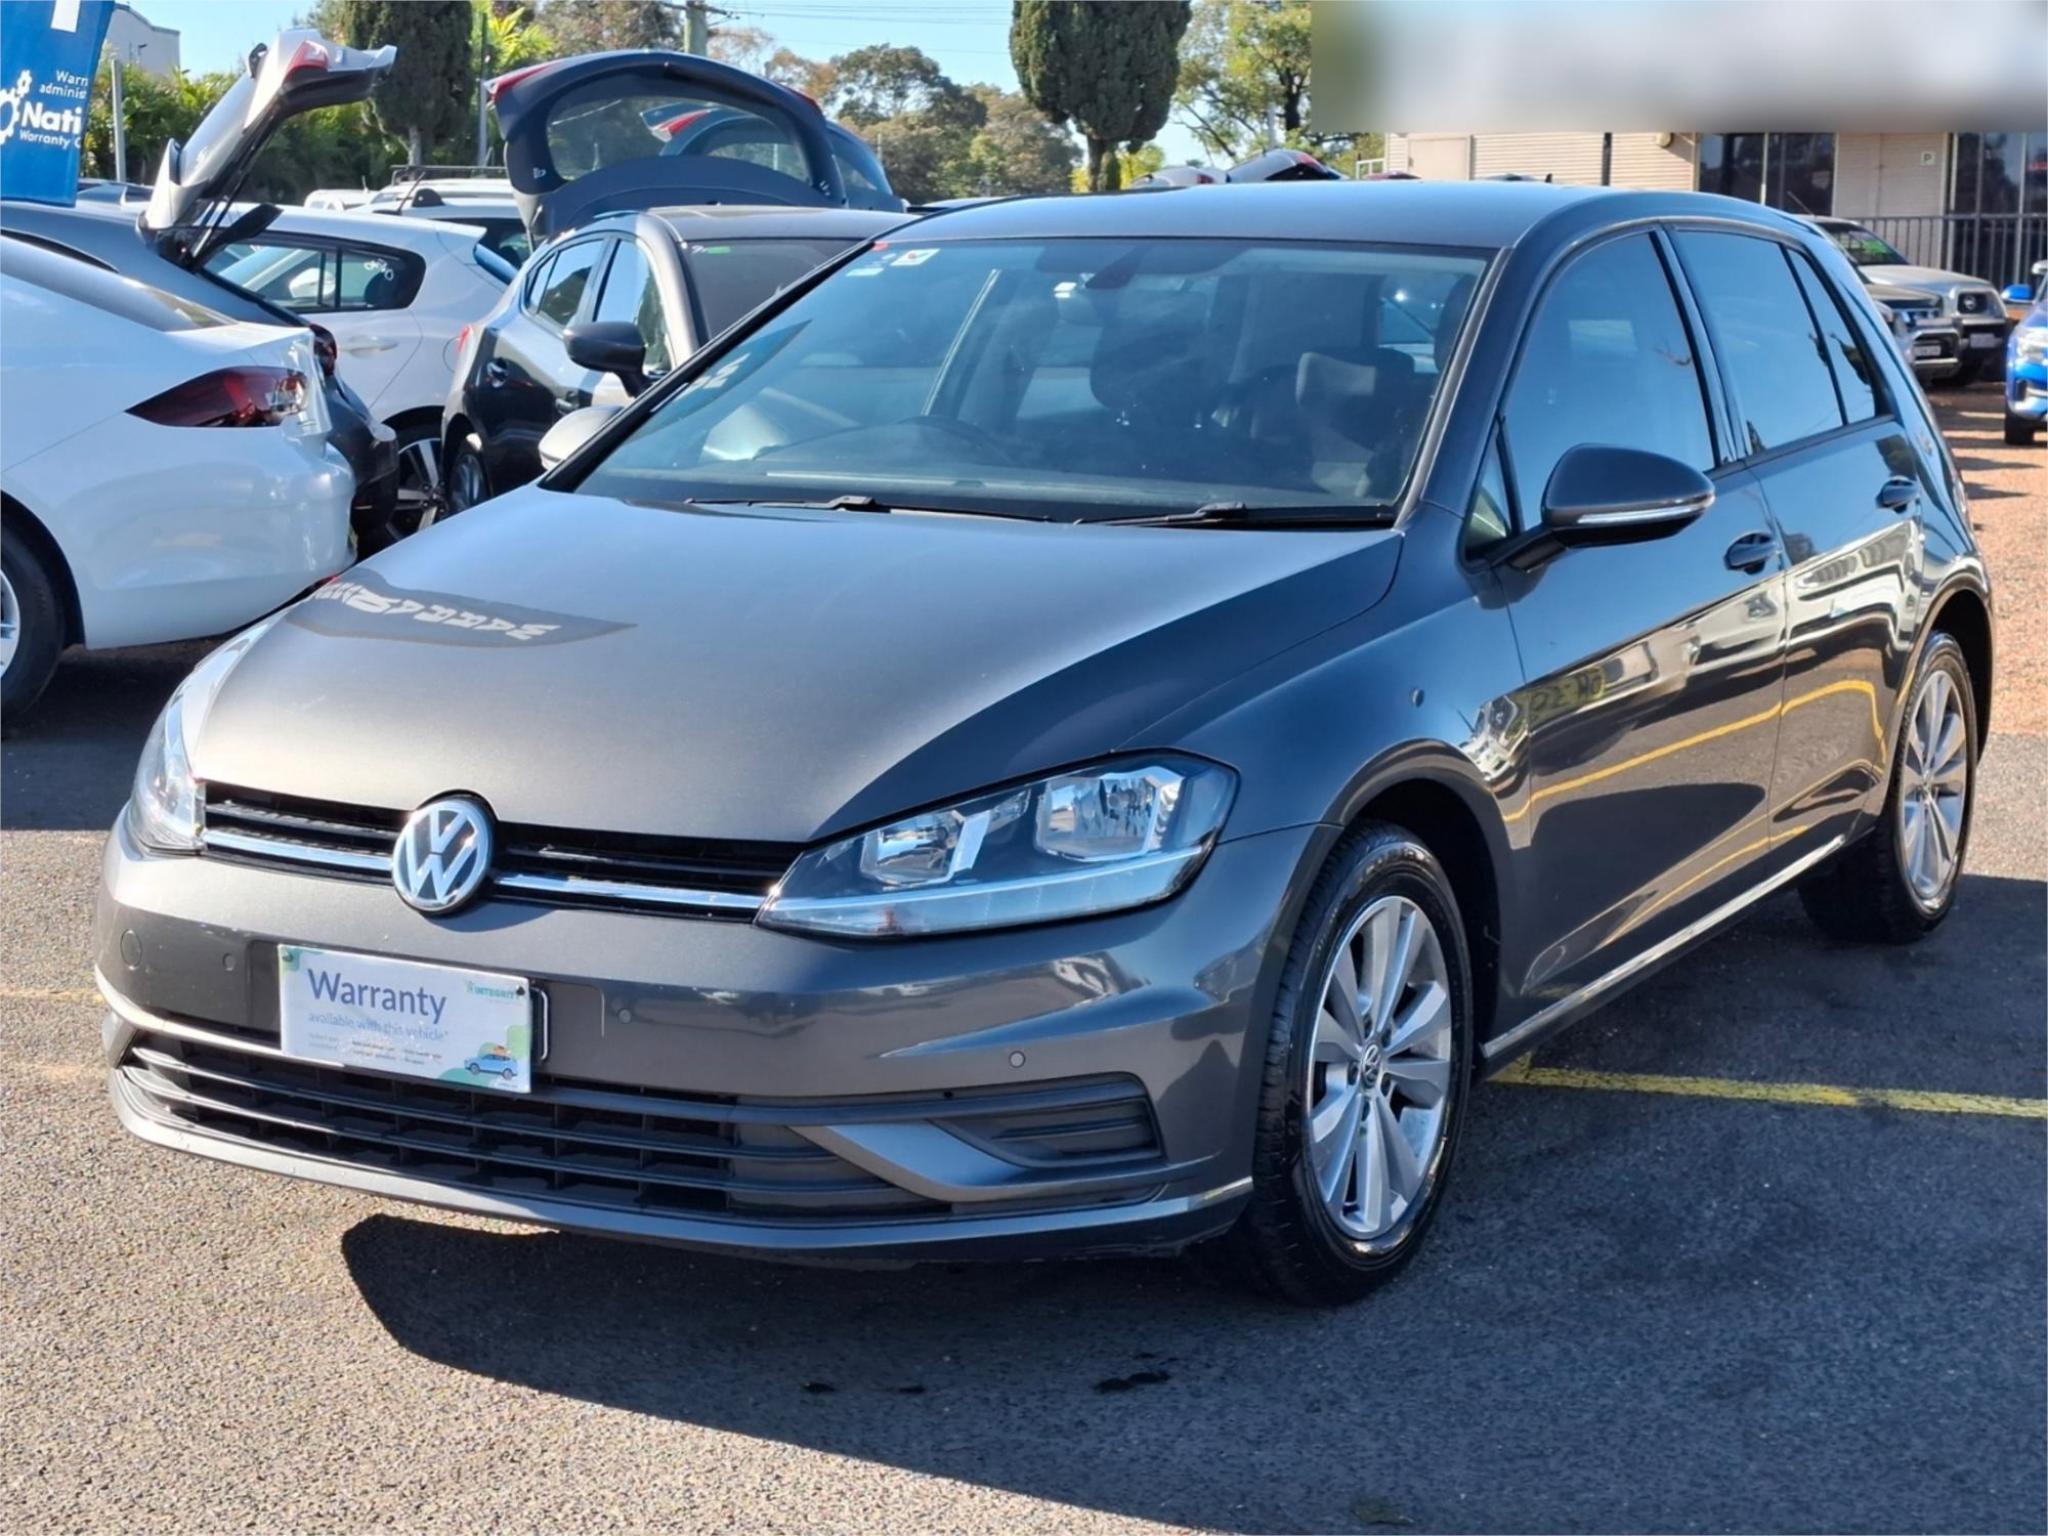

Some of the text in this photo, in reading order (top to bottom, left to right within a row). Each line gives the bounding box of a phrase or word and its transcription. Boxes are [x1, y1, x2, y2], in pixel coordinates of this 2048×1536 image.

[21, 101, 82, 135] Nati
[19, 129, 71, 151] Warranty
[307, 968, 448, 1024] Warranty
